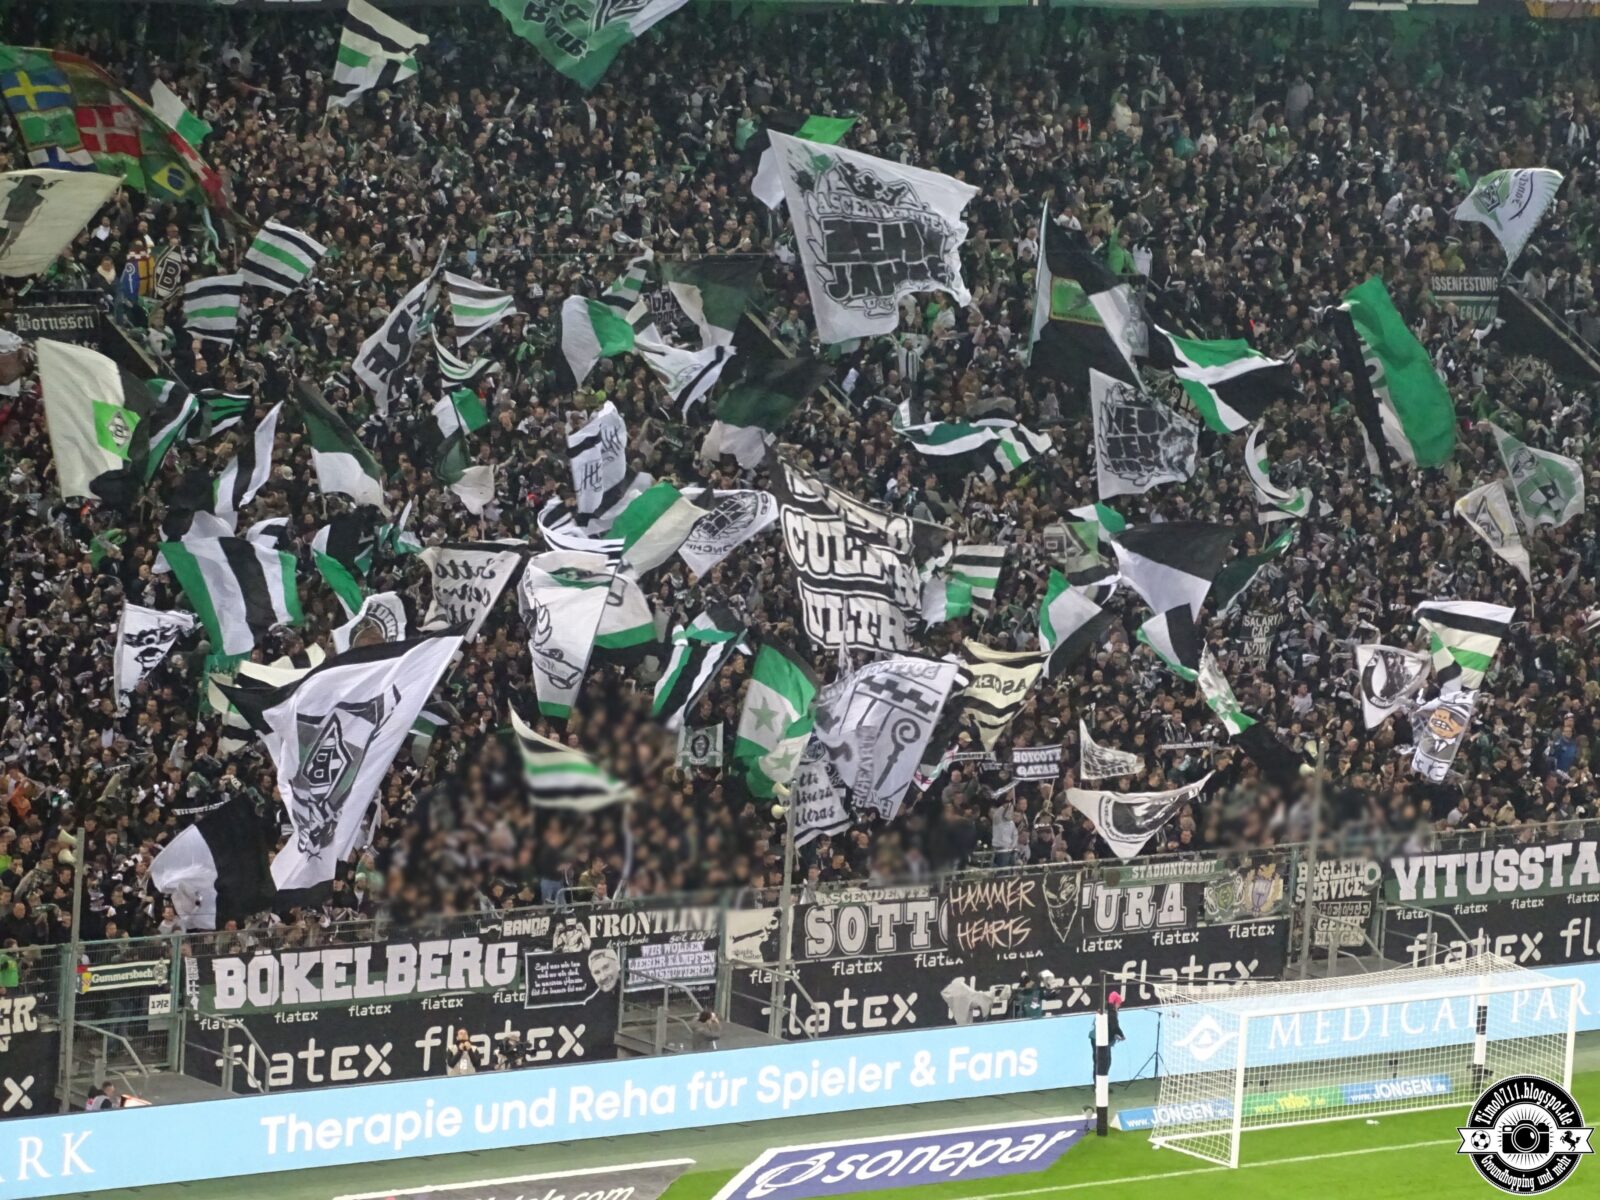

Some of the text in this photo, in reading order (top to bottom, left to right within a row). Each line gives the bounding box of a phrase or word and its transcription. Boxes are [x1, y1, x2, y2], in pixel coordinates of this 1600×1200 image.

[1016, 763, 1060, 778] QATAR
[949, 876, 1036, 916] HAMMER
[805, 896, 949, 958] SOTT
[957, 916, 1032, 951] HEARTS
[91, 968, 153, 984] Gummersbach
[260, 1046, 1039, 1155] Therapie und Reha für Spieler & Fans
[1372, 1079, 1434, 1101] JONGEN
[1150, 1102, 1214, 1125] JONGEN
[820, 1129, 1078, 1185] sonepar
